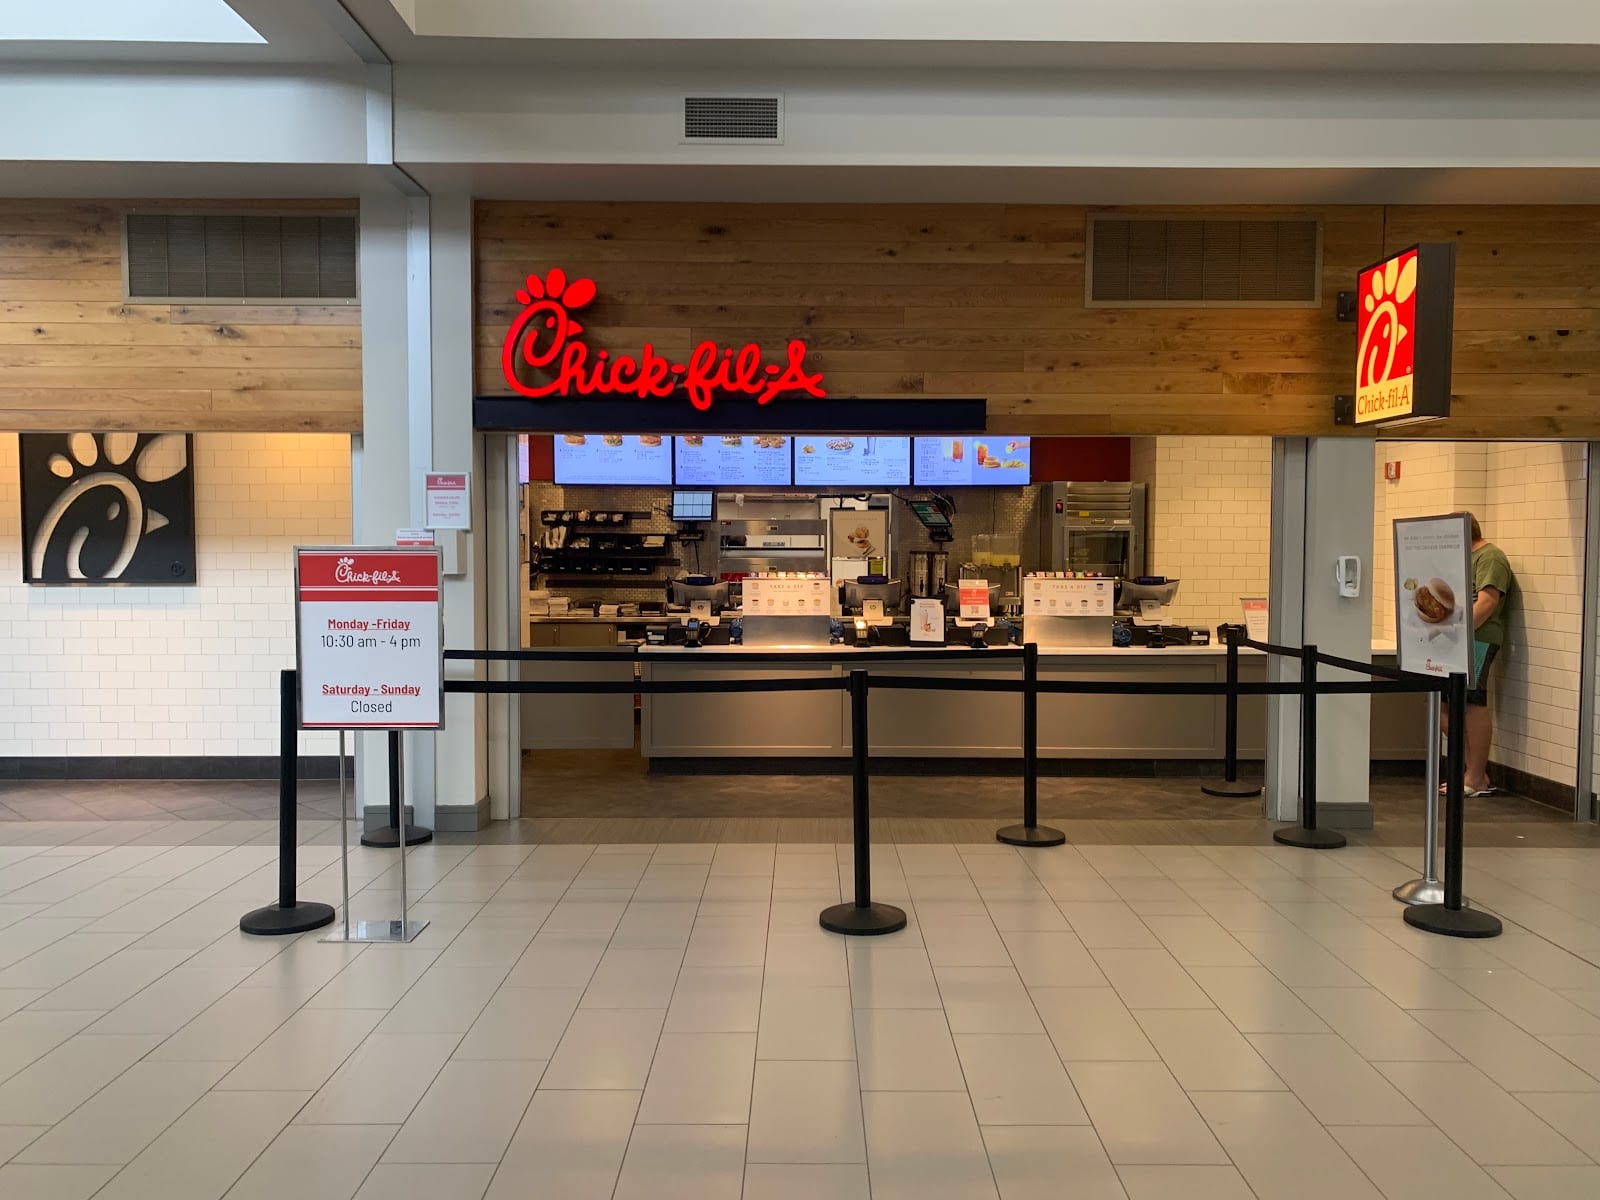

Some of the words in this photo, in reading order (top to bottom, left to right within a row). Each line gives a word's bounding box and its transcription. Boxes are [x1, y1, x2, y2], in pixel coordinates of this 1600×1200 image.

[502, 290, 827, 411] Chick-fil-A
[1357, 385, 1410, 415] Chick-fil-A
[335, 562, 401, 585] Chick-fil-A
[327, 618, 369, 631] Monday
[321, 634, 354, 648] 10:30
[357, 637, 377, 648] am
[389, 634, 397, 648] 4
[401, 637, 421, 650] pm
[322, 684, 371, 697] Saturday
[381, 684, 421, 697] Sunday
[351, 700, 393, 713] Closed
